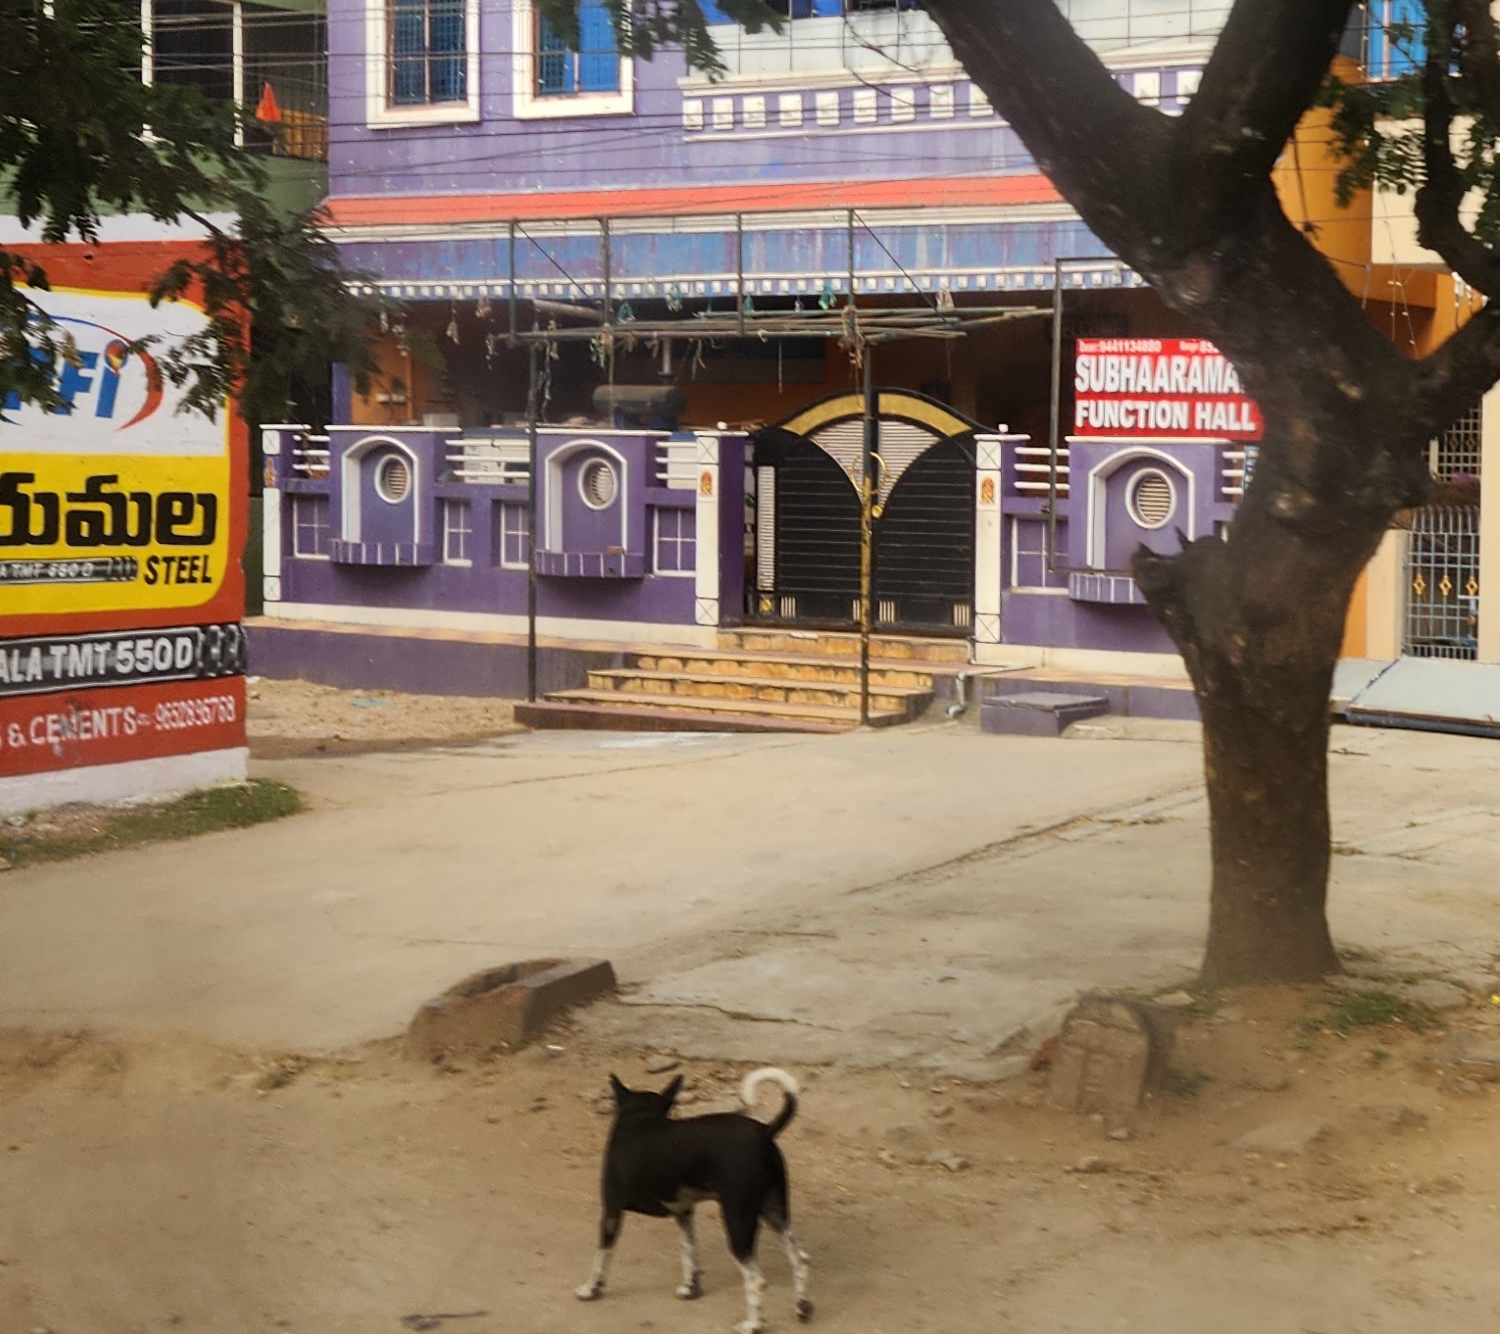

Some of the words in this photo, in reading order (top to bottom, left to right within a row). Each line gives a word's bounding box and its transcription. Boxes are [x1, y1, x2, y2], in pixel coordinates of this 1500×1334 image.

[1075, 354, 1246, 394] SUBHAARAMA
[1075, 399, 1189, 430] FUNCTION
[1195, 401, 1256, 432] HALL
[143, 554, 212, 585] STEEL
[49, 641, 112, 679] TMT
[114, 635, 194, 675] 550D
